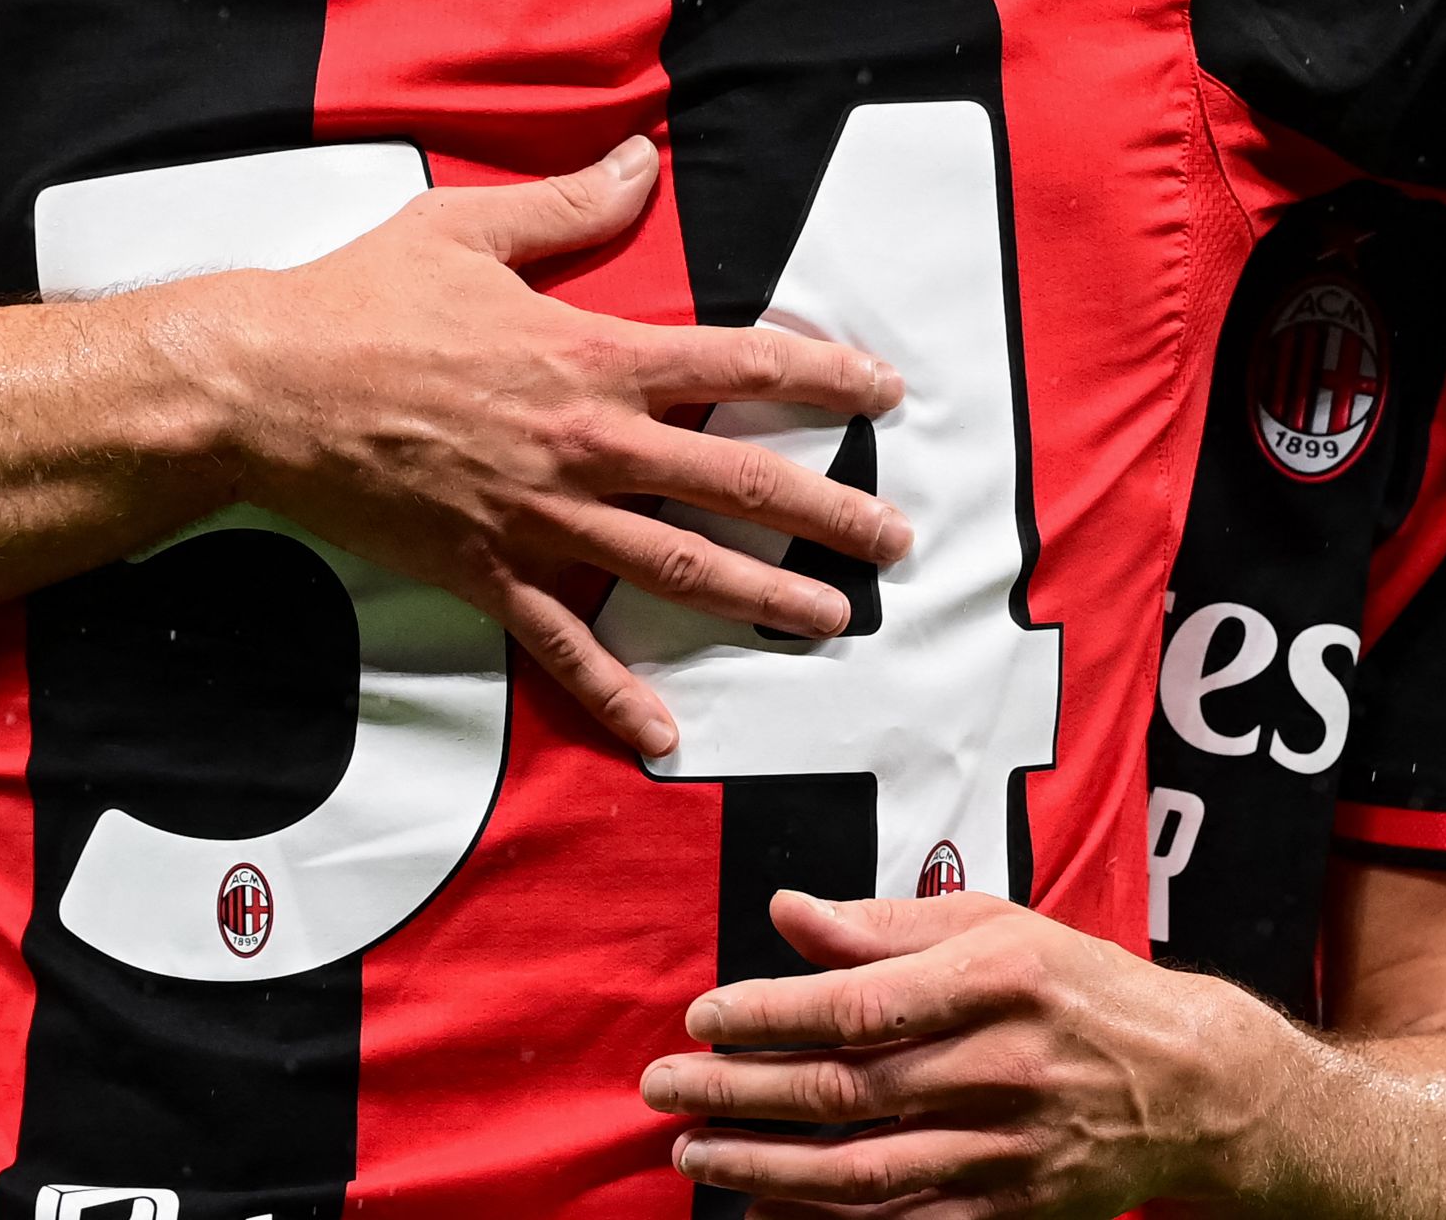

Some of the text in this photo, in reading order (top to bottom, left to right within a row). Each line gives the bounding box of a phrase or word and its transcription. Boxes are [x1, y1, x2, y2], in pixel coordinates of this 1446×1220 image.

[1290, 290, 1366, 333] ACM
[1275, 431, 1339, 459] 1899
[1160, 592, 1361, 775] es
[931, 847, 955, 864] ACM
[229, 871, 260, 887] ACM
[233, 936, 259, 947] 1899
